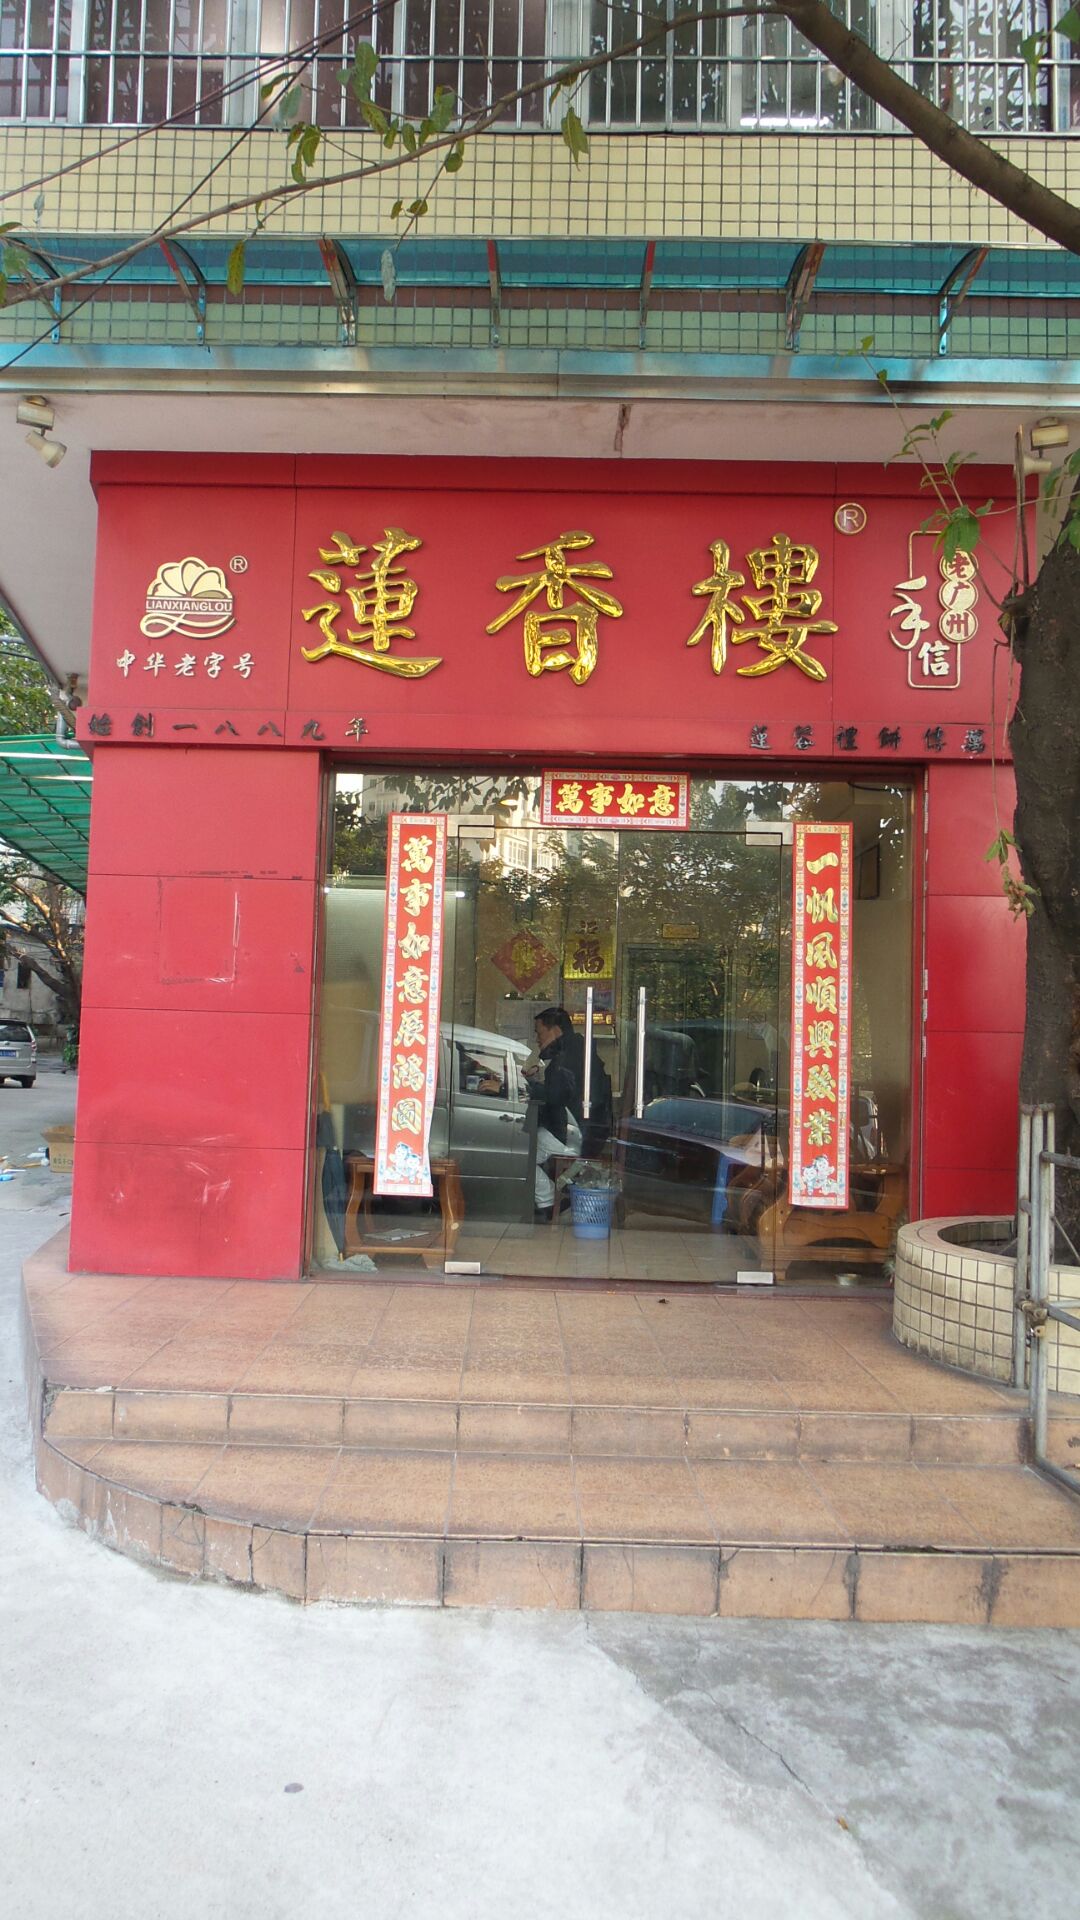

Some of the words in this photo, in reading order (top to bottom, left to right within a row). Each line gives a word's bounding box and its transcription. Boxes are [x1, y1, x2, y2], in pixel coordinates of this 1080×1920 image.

[145, 599, 233, 613] LIANXIANGLOU
[299, 526, 840, 687] 蓮香樓
[944, 551, 972, 638] 老广州
[116, 649, 255, 679] 中华老字号
[87, 712, 369, 744] 始創一八八九年
[555, 781, 676, 817] 萬事如意
[391, 834, 434, 1135] 萬事如意展鴻圖
